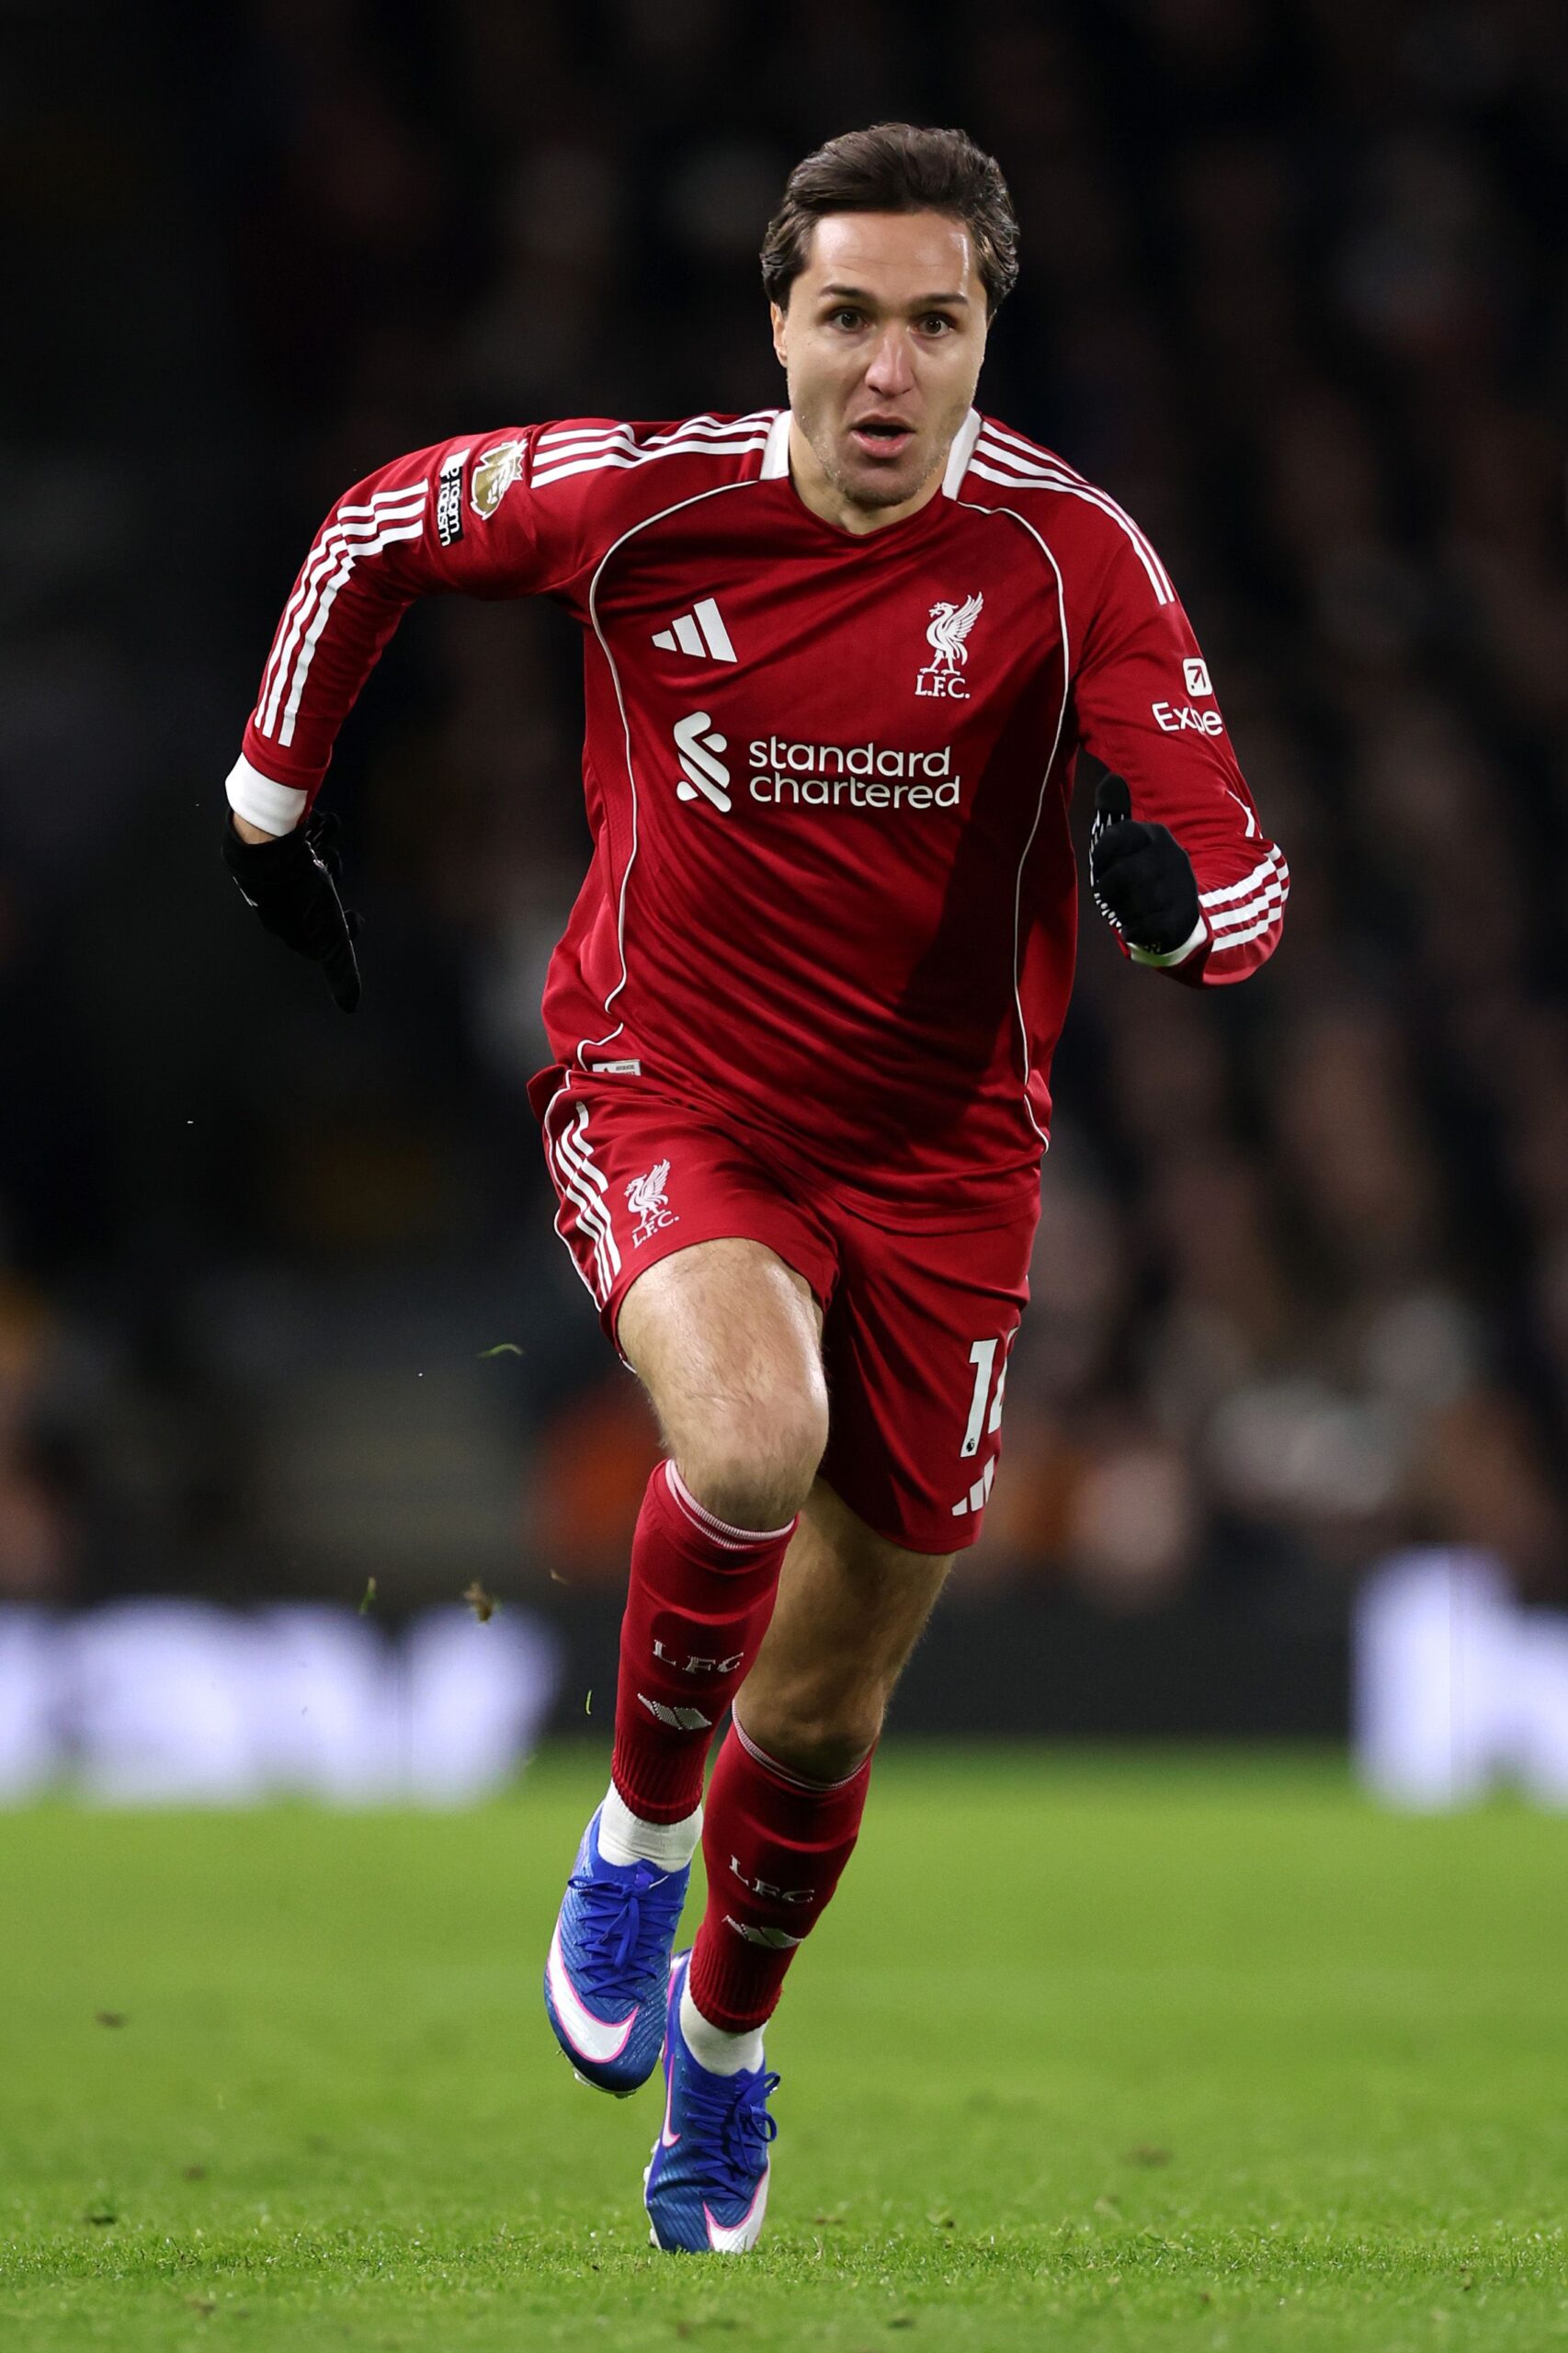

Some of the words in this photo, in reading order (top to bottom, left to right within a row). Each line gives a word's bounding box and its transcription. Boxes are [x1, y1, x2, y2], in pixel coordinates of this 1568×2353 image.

[449, 479, 460, 534] room
[915, 674, 971, 699] L.F.C.
[749, 735, 951, 777] standard
[749, 771, 960, 809] chartered
[631, 1210, 680, 1249] L.F.C.
[653, 1639, 744, 1673] LFC
[729, 1854, 815, 1904] LFC
